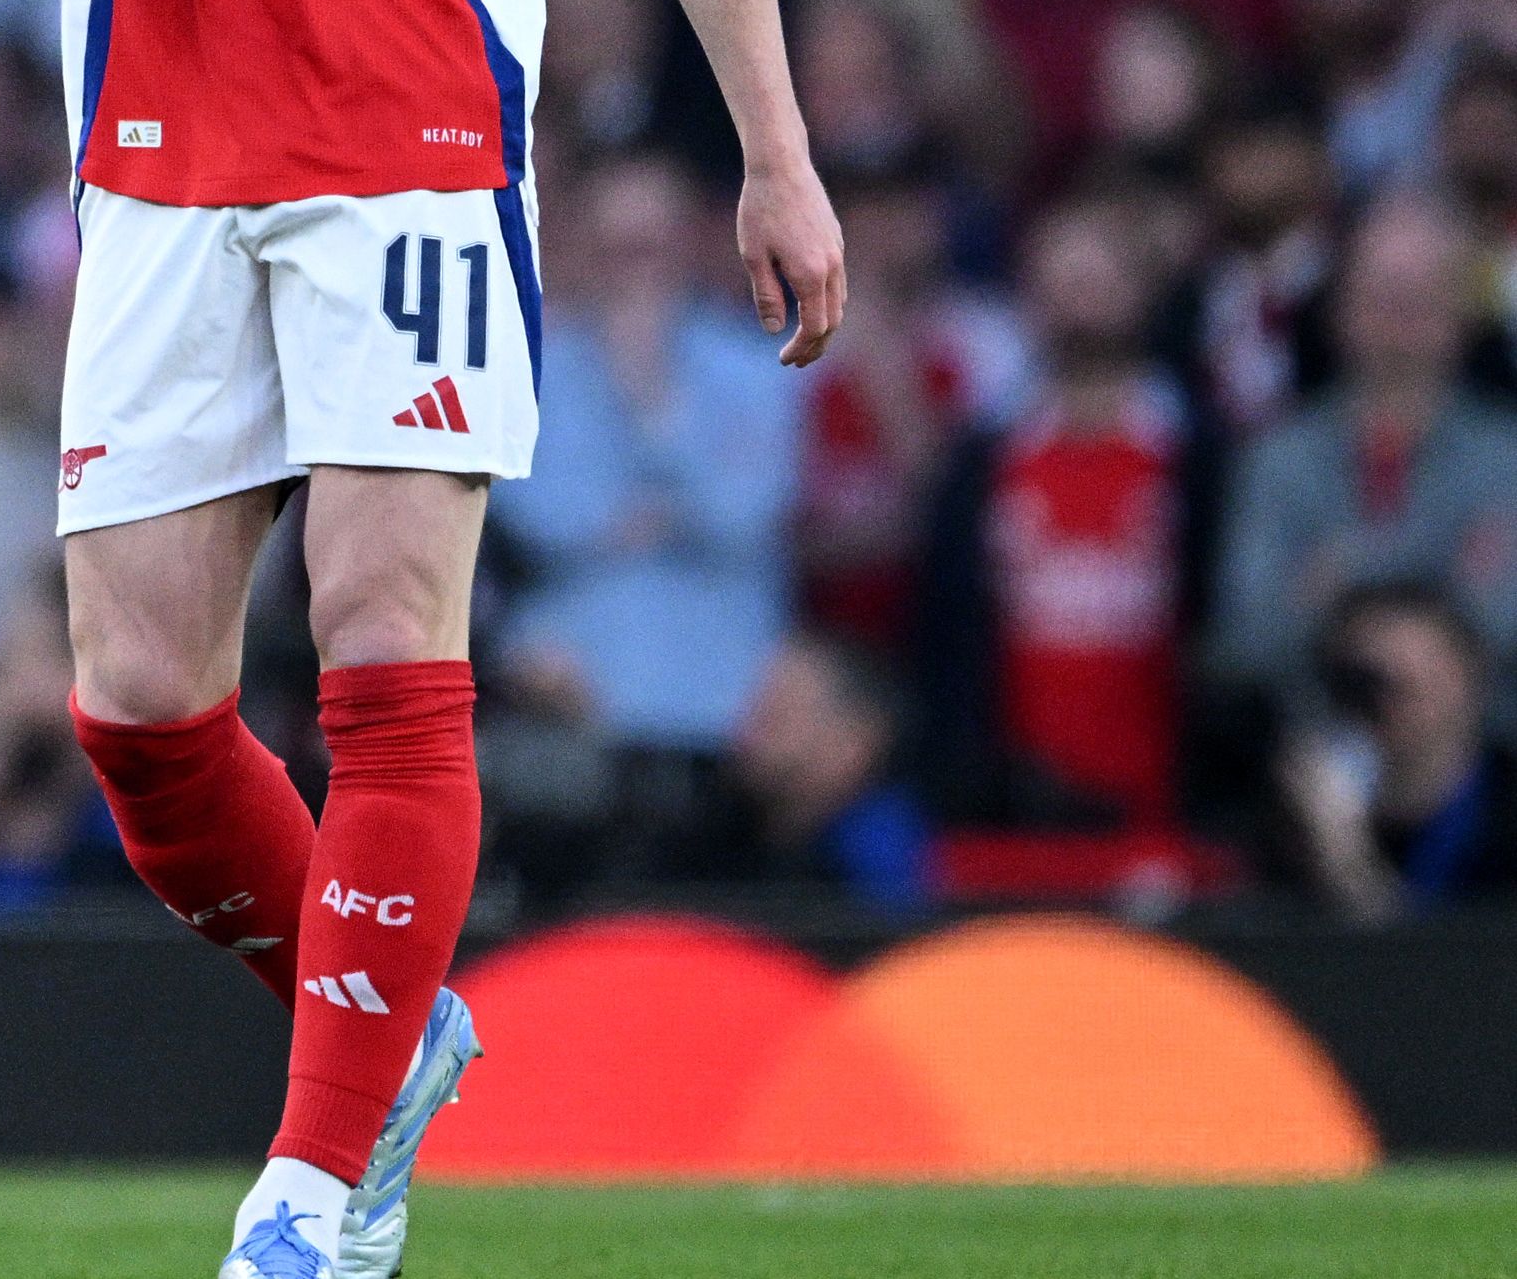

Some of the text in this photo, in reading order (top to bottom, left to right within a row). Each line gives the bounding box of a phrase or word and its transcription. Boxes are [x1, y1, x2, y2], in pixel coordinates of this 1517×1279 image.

[422, 128, 484, 149] HEAT.RDY
[380, 232, 489, 372] 41
[320, 879, 415, 926] AFC
